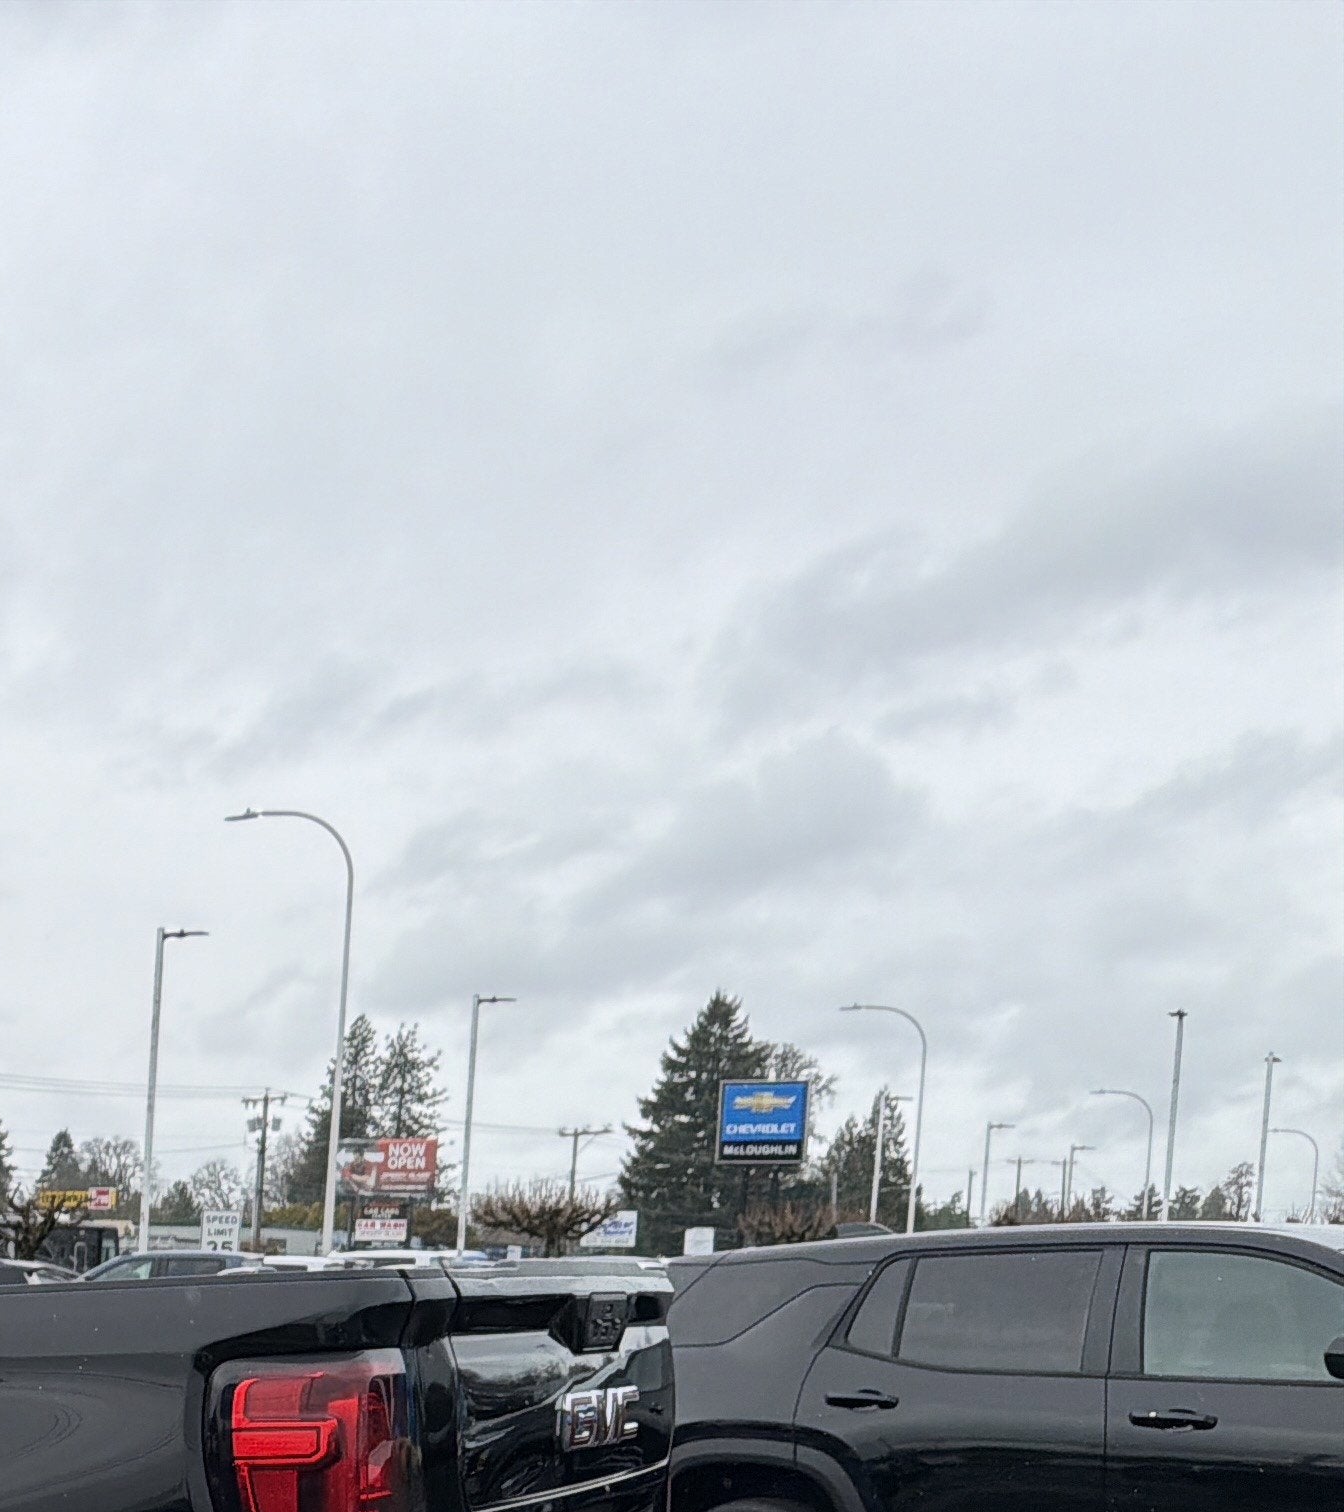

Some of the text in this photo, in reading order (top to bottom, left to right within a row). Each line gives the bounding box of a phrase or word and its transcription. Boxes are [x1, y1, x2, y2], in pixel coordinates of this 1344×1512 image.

[725, 1122, 796, 1135] CHEVROLET
[388, 1141, 426, 1157] NOW
[387, 1156, 426, 1170] OPEN
[205, 1215, 238, 1225] SPEED
[207, 1228, 234, 1237] LIMIT
[555, 1384, 640, 1452] GMC
